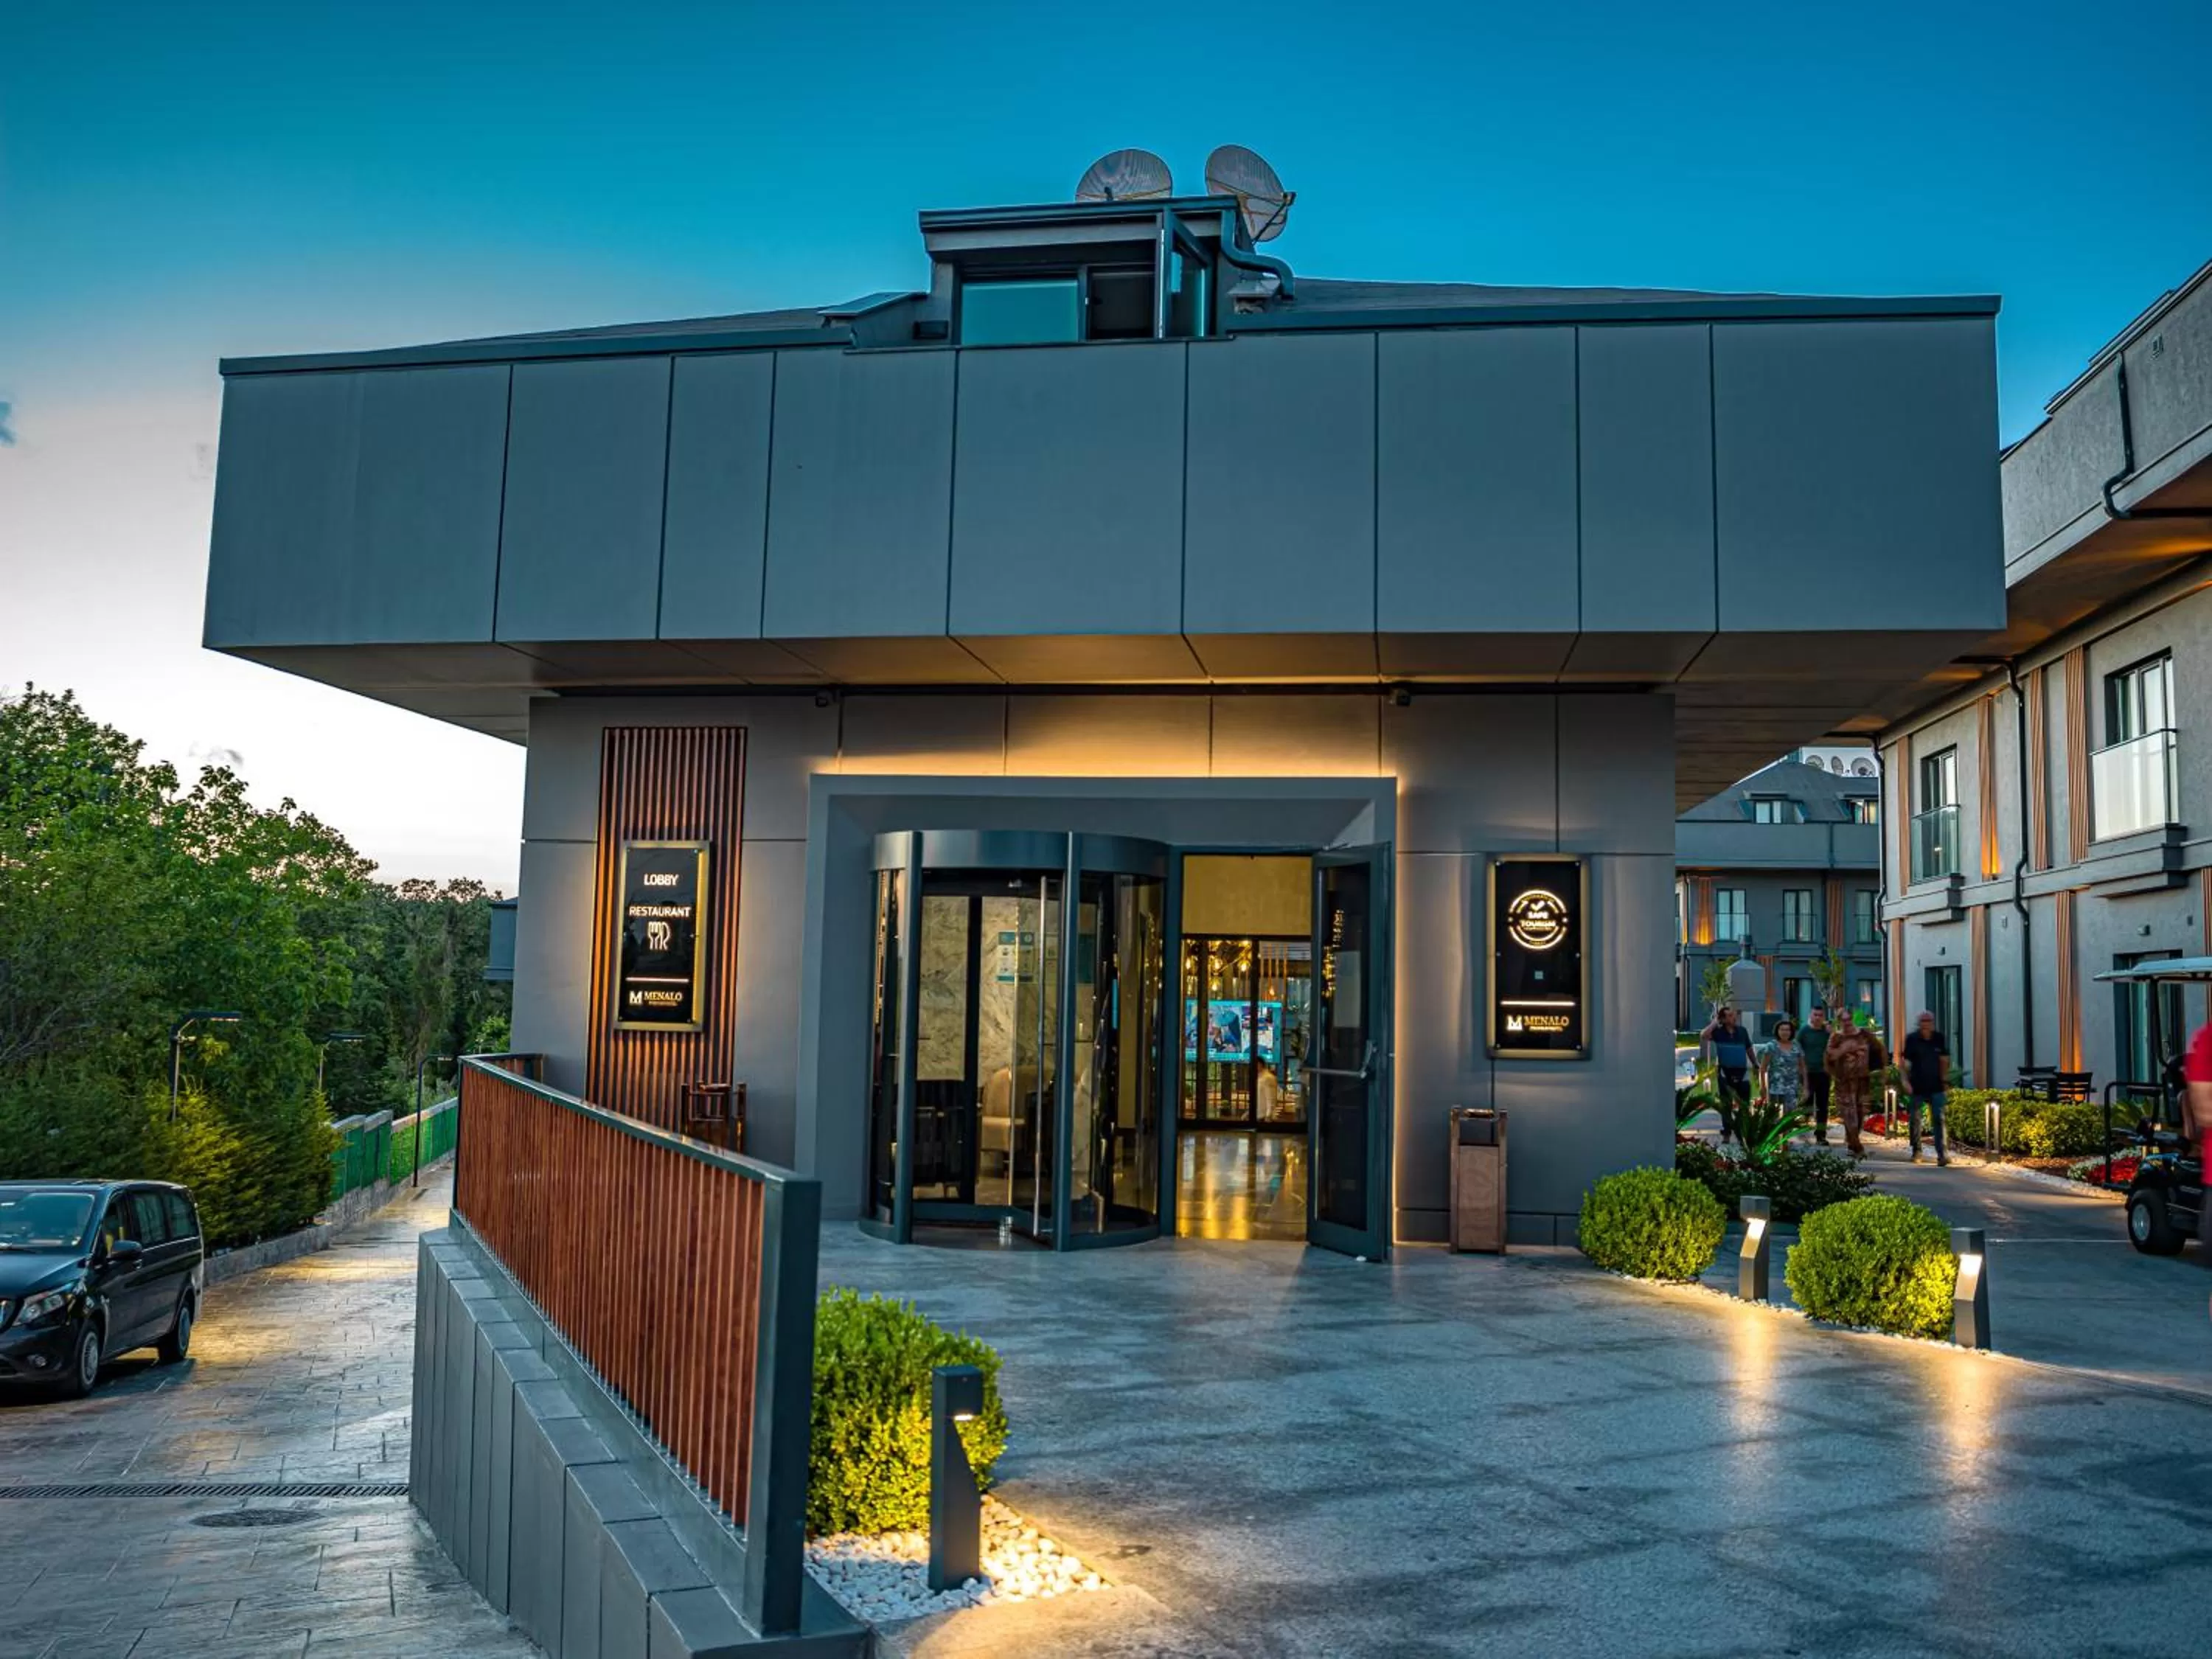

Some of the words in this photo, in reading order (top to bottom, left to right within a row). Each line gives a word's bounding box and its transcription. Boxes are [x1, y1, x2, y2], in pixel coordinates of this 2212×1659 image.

[644, 874, 679, 886] LOBBY
[629, 905, 692, 918] RESTAURANT
[644, 990, 683, 1001] MENALO
[1523, 1015, 1570, 1027] MENALO
